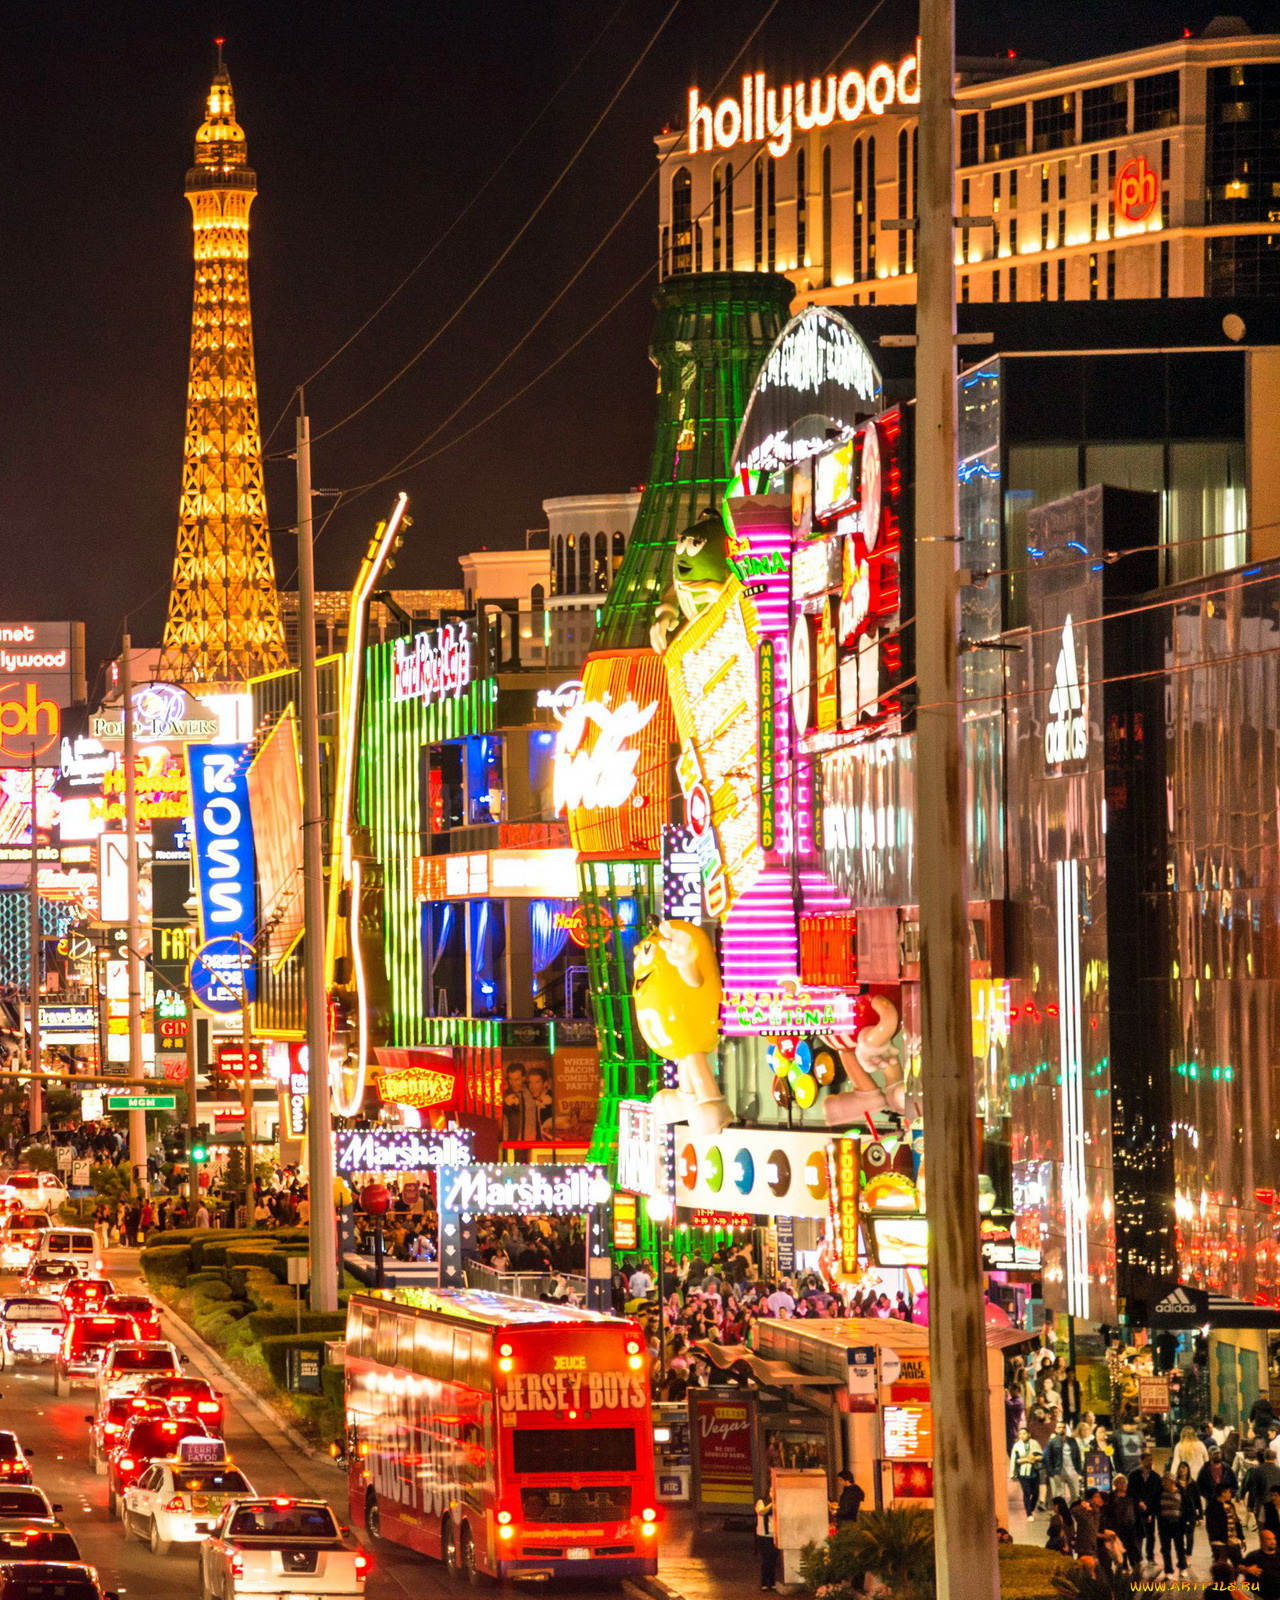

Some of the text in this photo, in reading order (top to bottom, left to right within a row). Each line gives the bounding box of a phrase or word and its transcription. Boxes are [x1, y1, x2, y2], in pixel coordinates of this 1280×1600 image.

[688, 36, 920, 158] hollywood
[94, 718, 218, 736] POO TOWERS
[761, 644, 772, 774] MARGARITAS
[1045, 705, 1087, 764] adidas
[202, 754, 243, 923] ROSS
[762, 794, 773, 847] YARD
[670, 837, 701, 917] halls
[563, 1058, 595, 1066] WHERE
[128, 1098, 156, 1107] MGM
[386, 1077, 450, 1098] Denny's
[339, 1131, 473, 1168] Marshalls
[841, 1140, 854, 1196] FOOD
[445, 1168, 596, 1211] Marshall
[841, 1200, 855, 1273] COURT
[1155, 1303, 1197, 1314] adidas
[500, 1370, 647, 1412] JERSEY BOYS
[899, 1370, 926, 1380] PRICE
[698, 1414, 751, 1440] Vegas
[188, 1445, 218, 1453] TERRY
